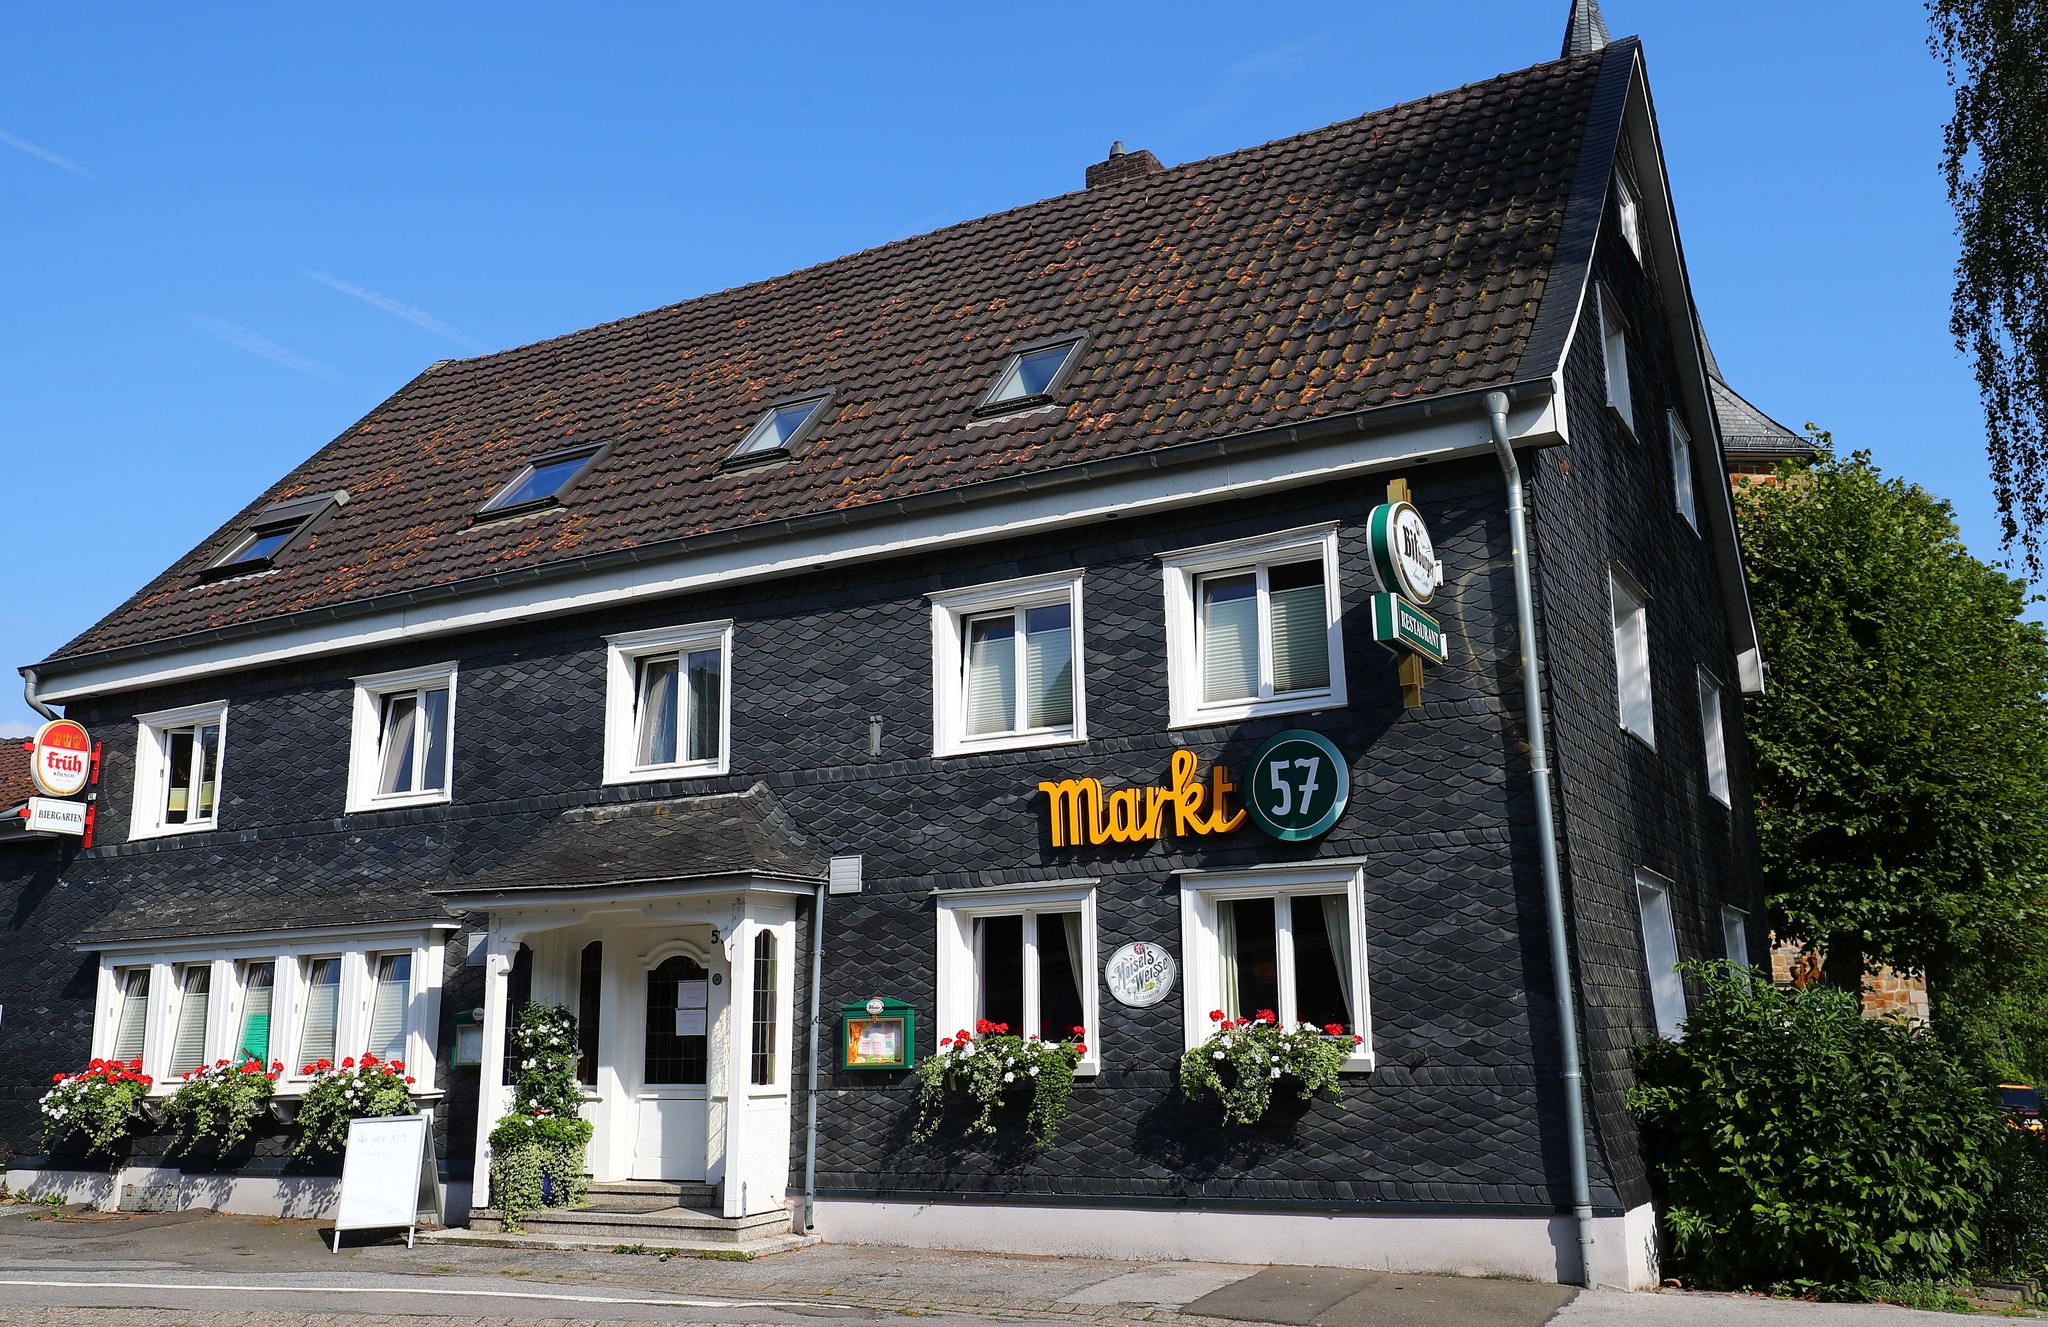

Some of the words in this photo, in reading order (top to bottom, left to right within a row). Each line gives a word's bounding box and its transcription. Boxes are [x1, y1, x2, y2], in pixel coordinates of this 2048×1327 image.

[1401, 610, 1440, 650] RESTAURANT
[53, 770, 75, 778] KÖLSCH
[1269, 756, 1321, 816] 57
[38, 809, 83, 823] BIERGARTEN
[1113, 946, 1154, 992] Maisel's
[1131, 957, 1168, 991] Weisse
